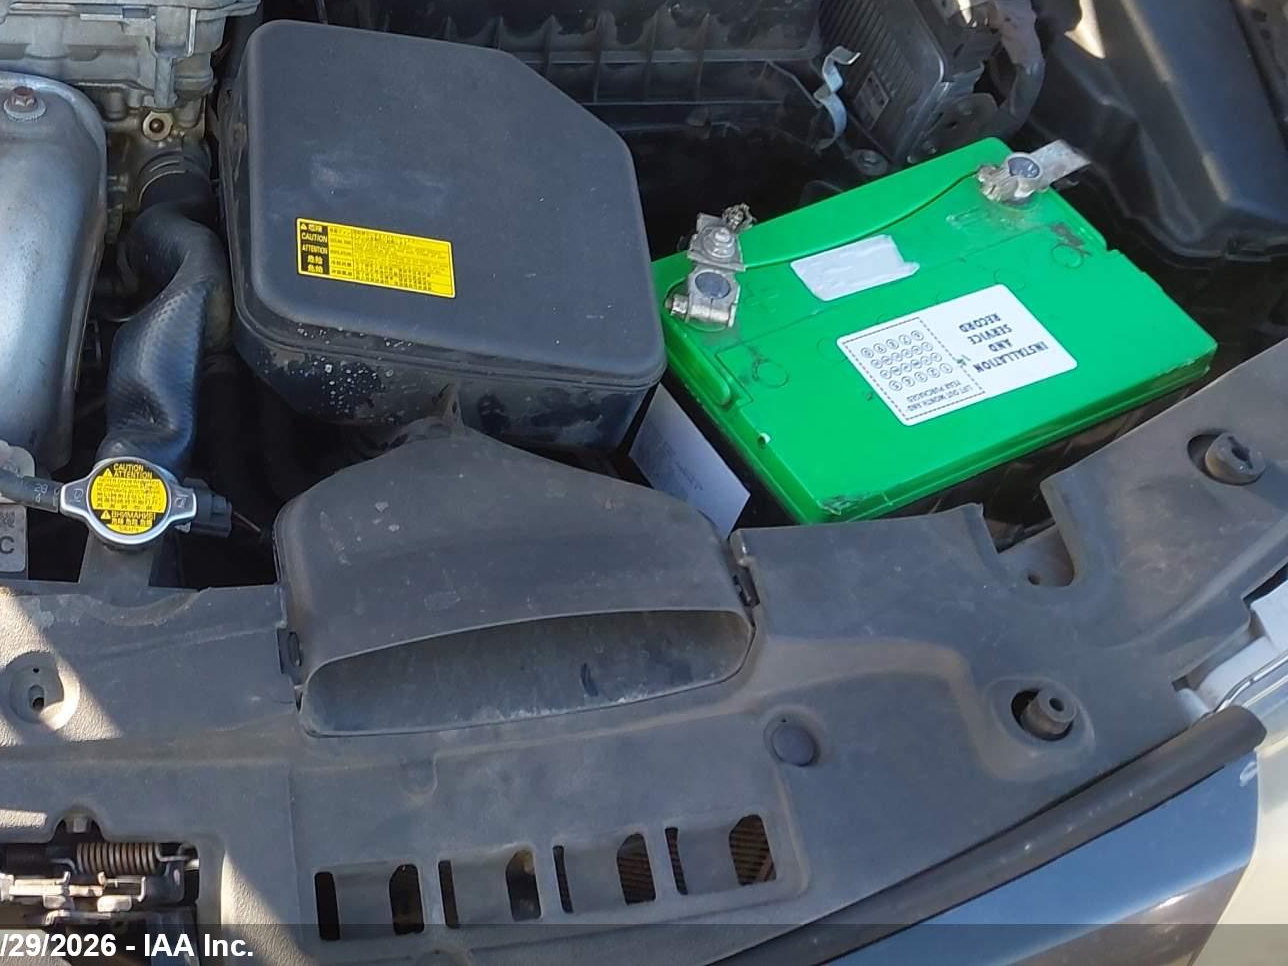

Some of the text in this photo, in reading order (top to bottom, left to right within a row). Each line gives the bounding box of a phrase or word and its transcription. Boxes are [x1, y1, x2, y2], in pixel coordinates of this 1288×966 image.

[301, 232, 328, 243] CAUTION
[302, 243, 328, 255] ATTENTION
[959, 313, 1001, 332] RECORD
[967, 323, 1013, 345] SERVICE
[988, 338, 1013, 352] AND
[972, 340, 1049, 373] INSTALLATION
[113, 463, 144, 472] CAUTION
[113, 470, 153, 480] ATTENTION
